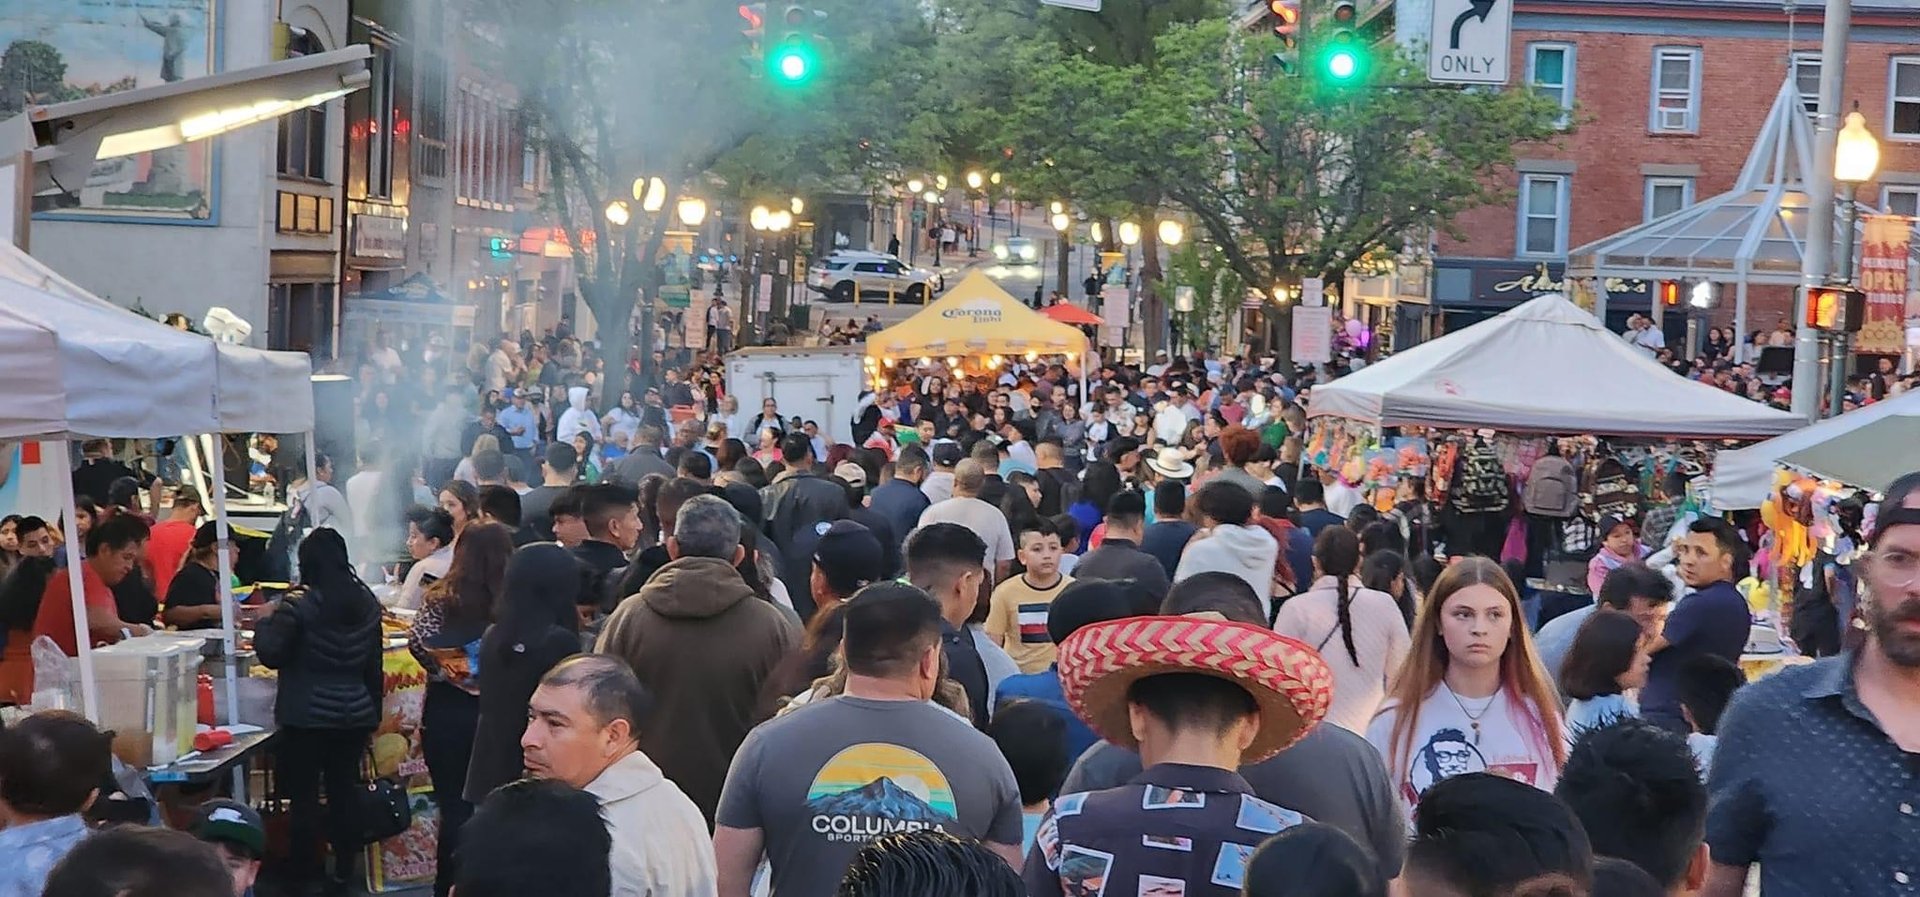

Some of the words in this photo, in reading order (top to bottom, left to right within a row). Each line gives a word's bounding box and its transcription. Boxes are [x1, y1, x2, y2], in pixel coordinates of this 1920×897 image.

[1441, 55, 1495, 73] ONLY
[1862, 270, 1905, 291] OPEN
[942, 308, 1002, 318] Corona
